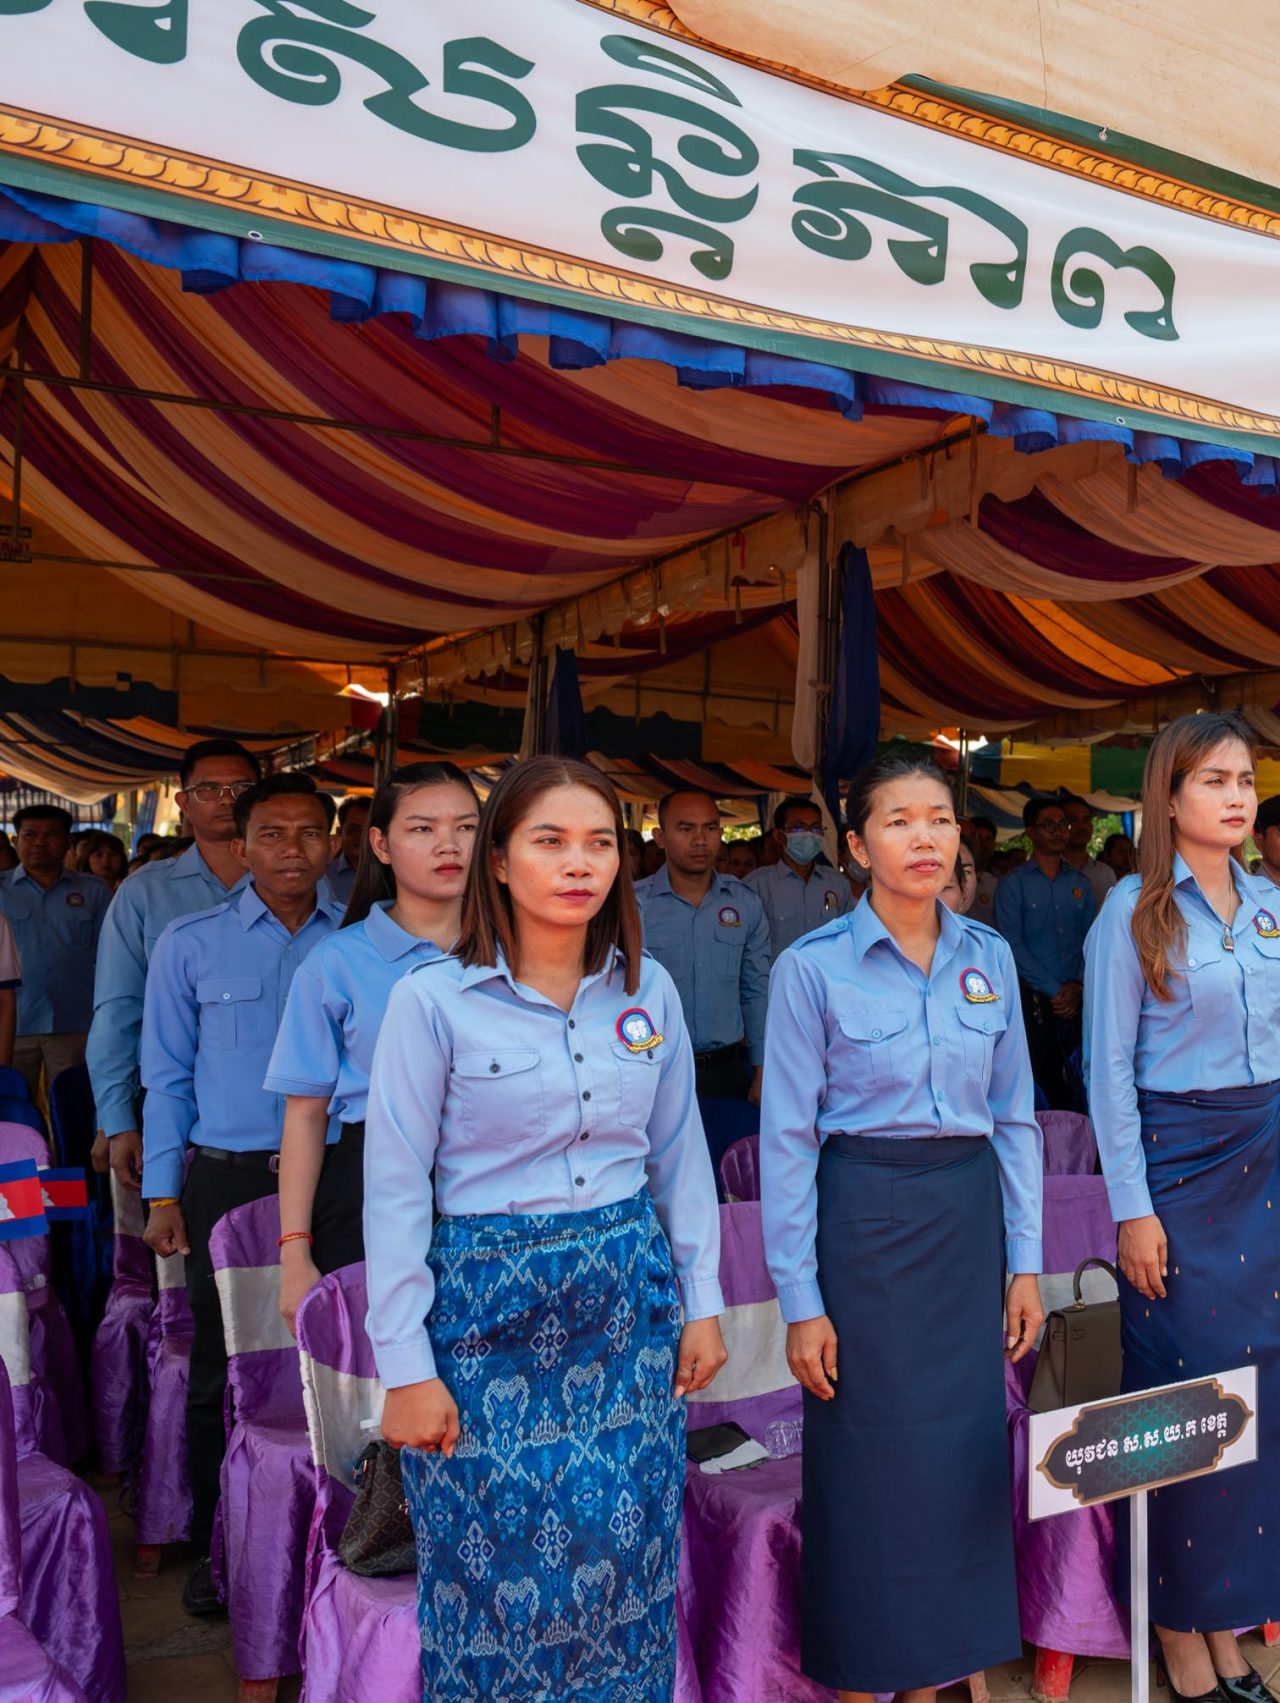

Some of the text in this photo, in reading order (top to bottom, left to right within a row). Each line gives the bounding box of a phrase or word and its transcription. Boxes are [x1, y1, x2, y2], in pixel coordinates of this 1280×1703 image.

[0, 0, 1181, 342] សន្តិភាព
[1065, 1438, 1119, 1475] យុវជន
[1201, 1411, 1228, 1439] ខេត្ត
